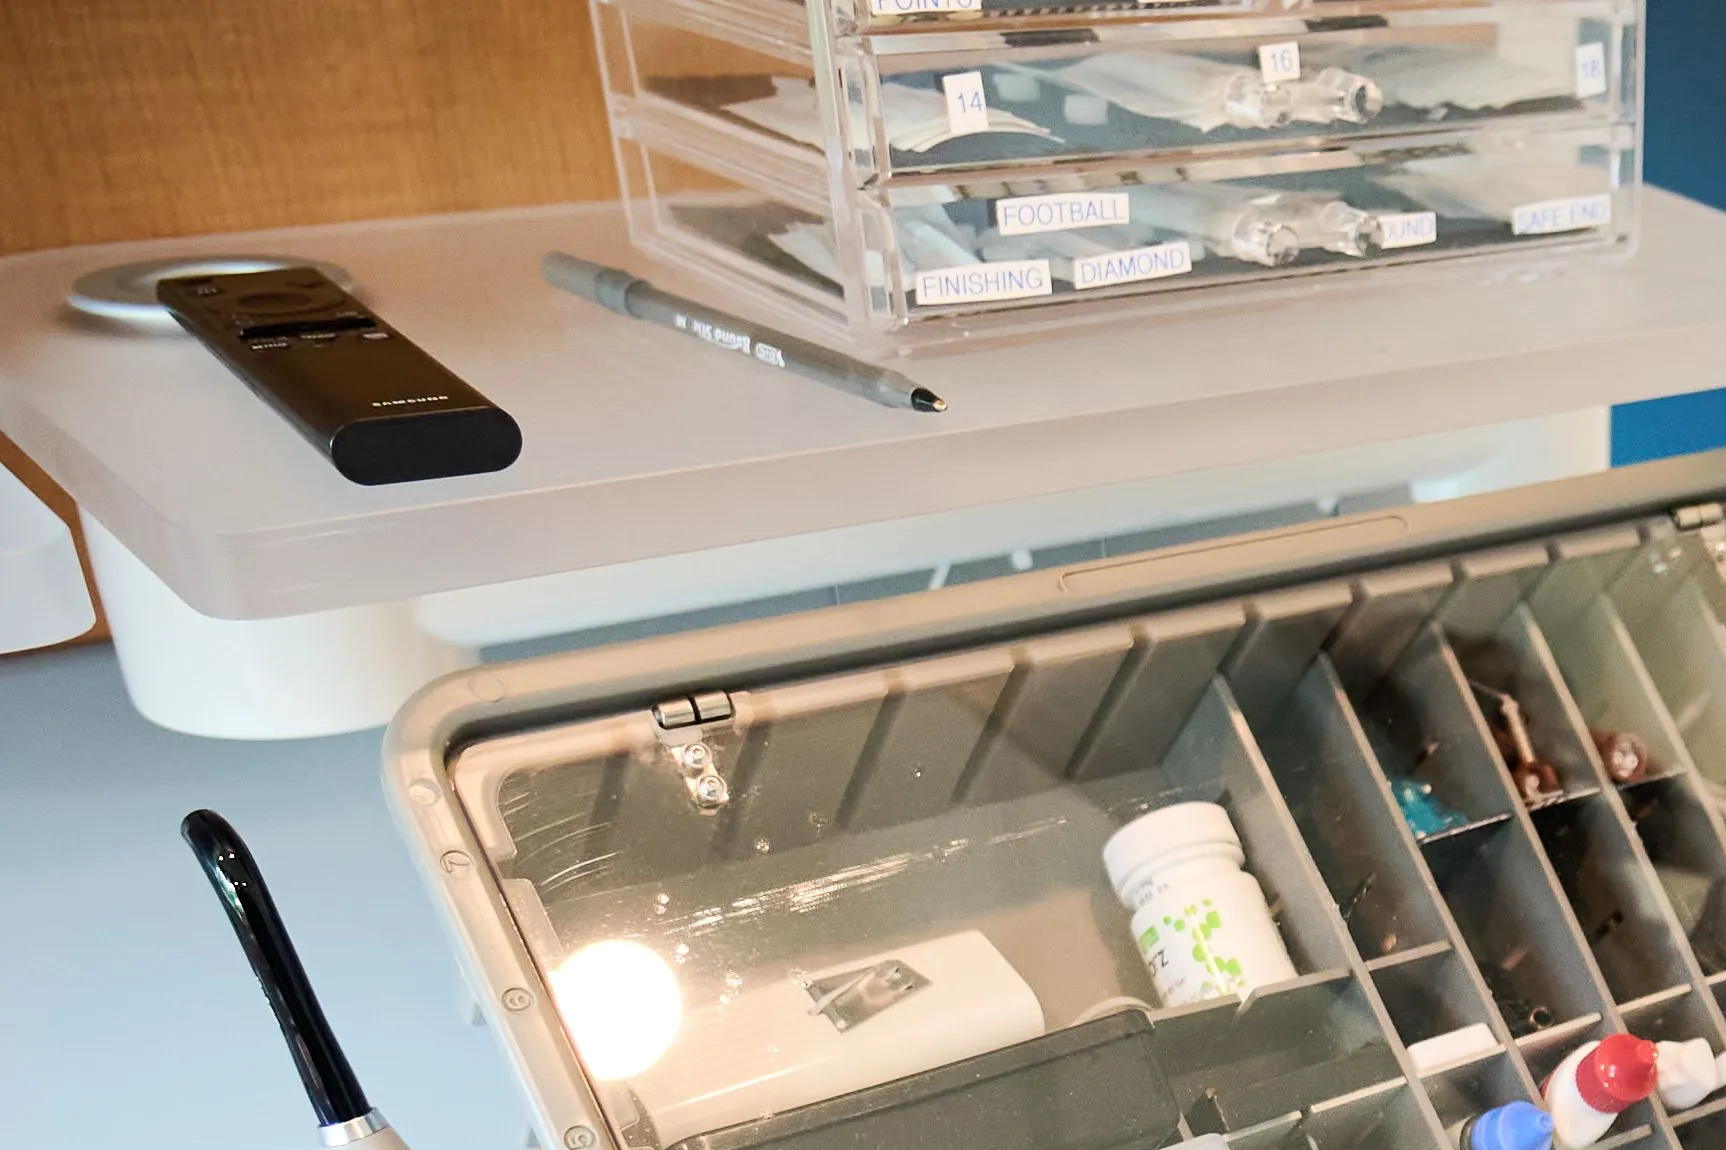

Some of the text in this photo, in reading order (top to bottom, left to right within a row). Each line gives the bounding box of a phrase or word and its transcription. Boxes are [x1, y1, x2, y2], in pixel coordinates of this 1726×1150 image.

[1270, 49, 1294, 73] 16
[957, 92, 984, 113] 14
[1003, 200, 1125, 227] FOOTBALL
[922, 249, 1185, 297] FINISHING DIAMOND
